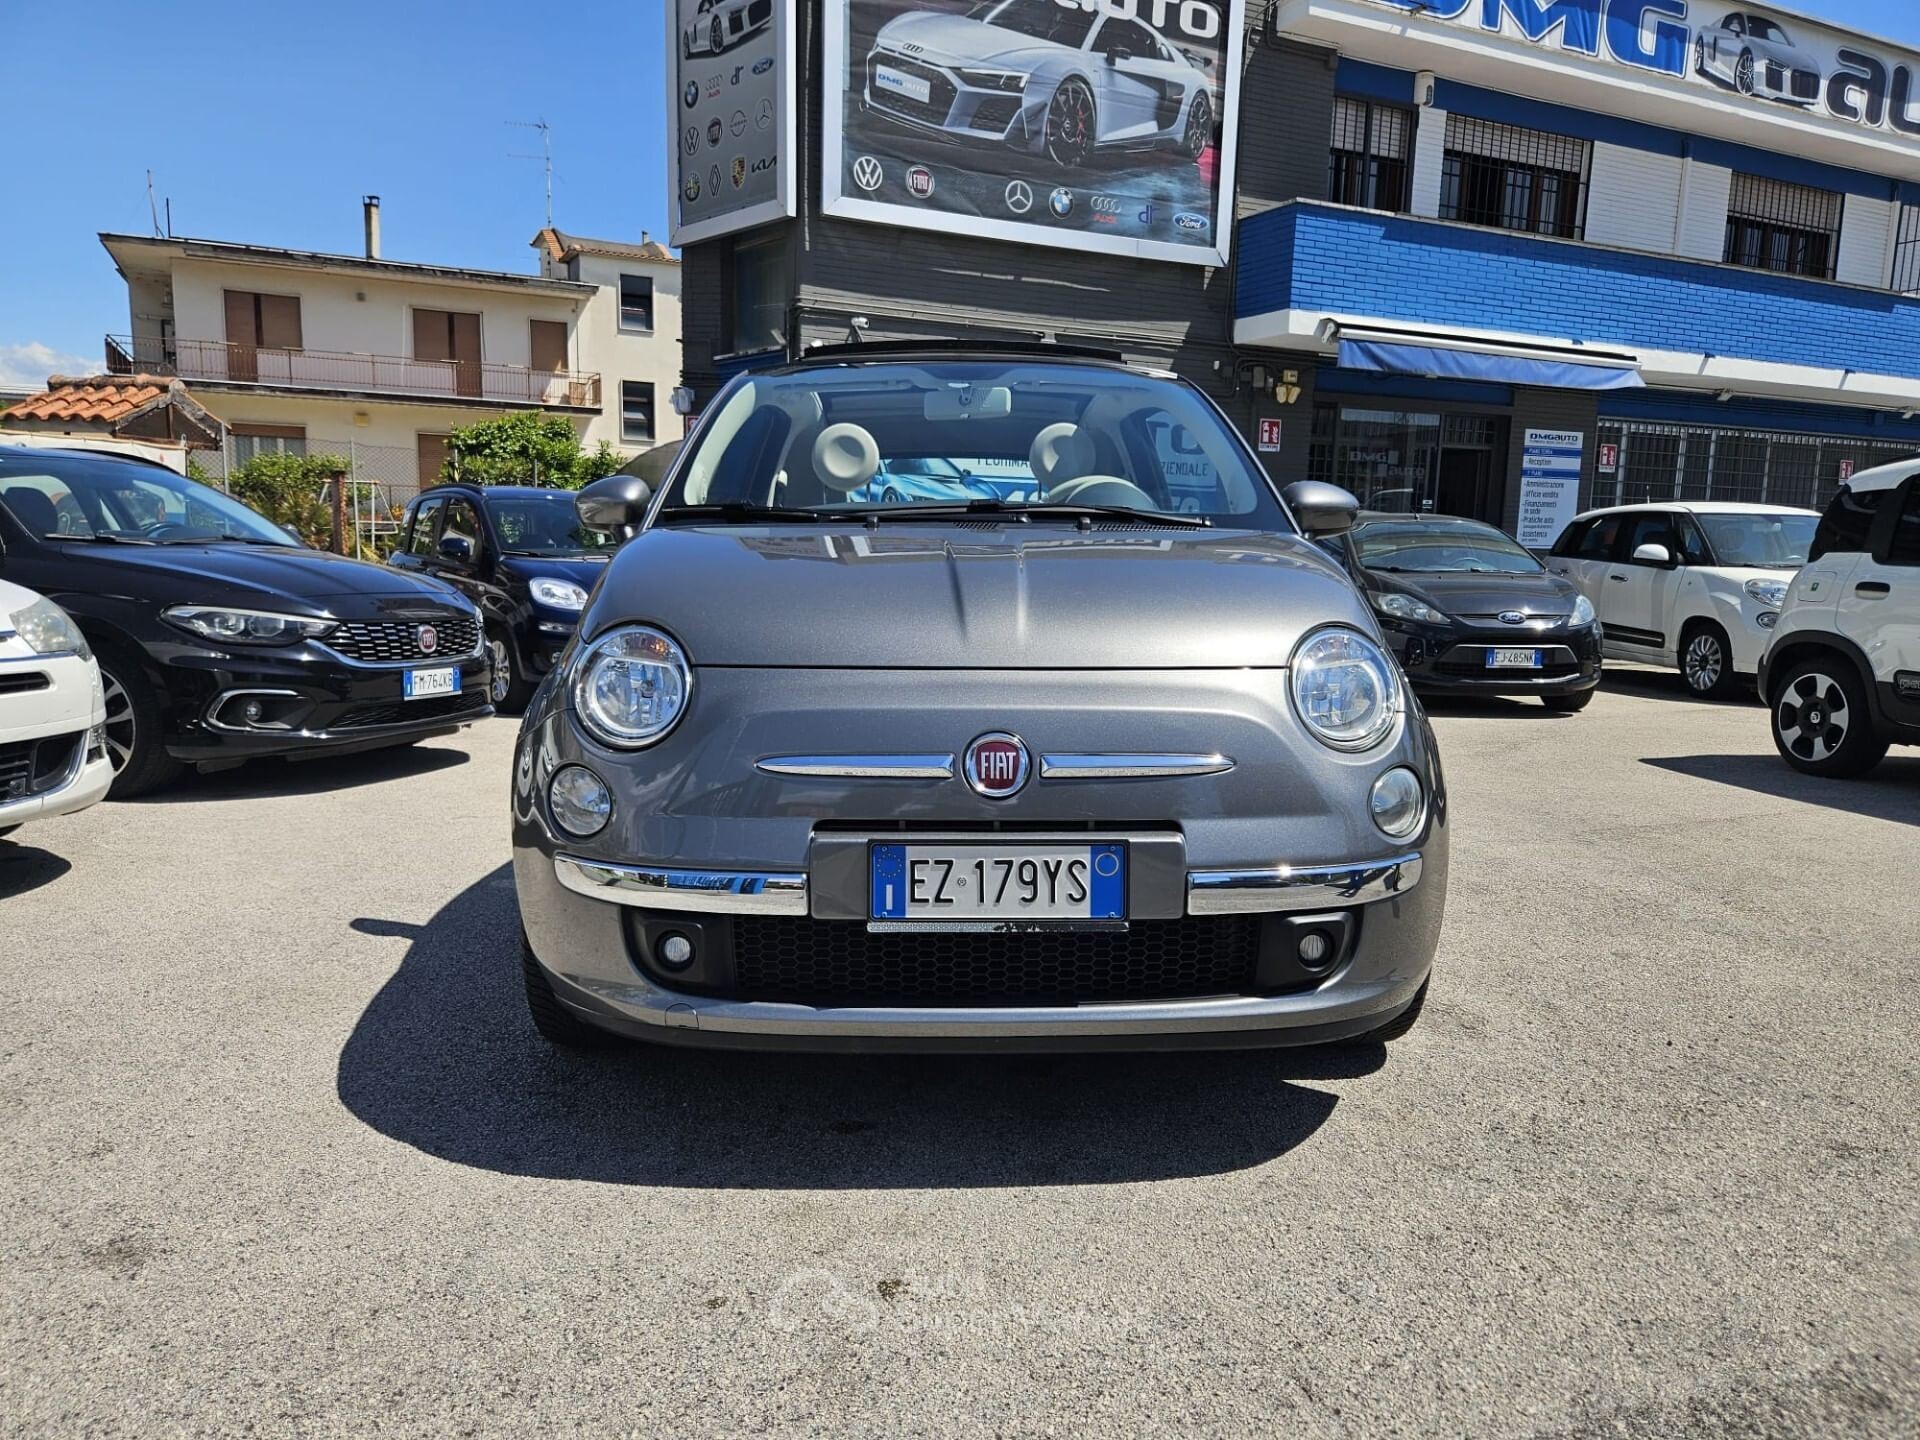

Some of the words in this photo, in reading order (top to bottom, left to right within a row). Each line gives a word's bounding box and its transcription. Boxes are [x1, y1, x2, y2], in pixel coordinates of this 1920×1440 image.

[980, 751, 1017, 780] FIAT
[909, 859, 955, 904] EZ
[974, 859, 1088, 904] 179YS
